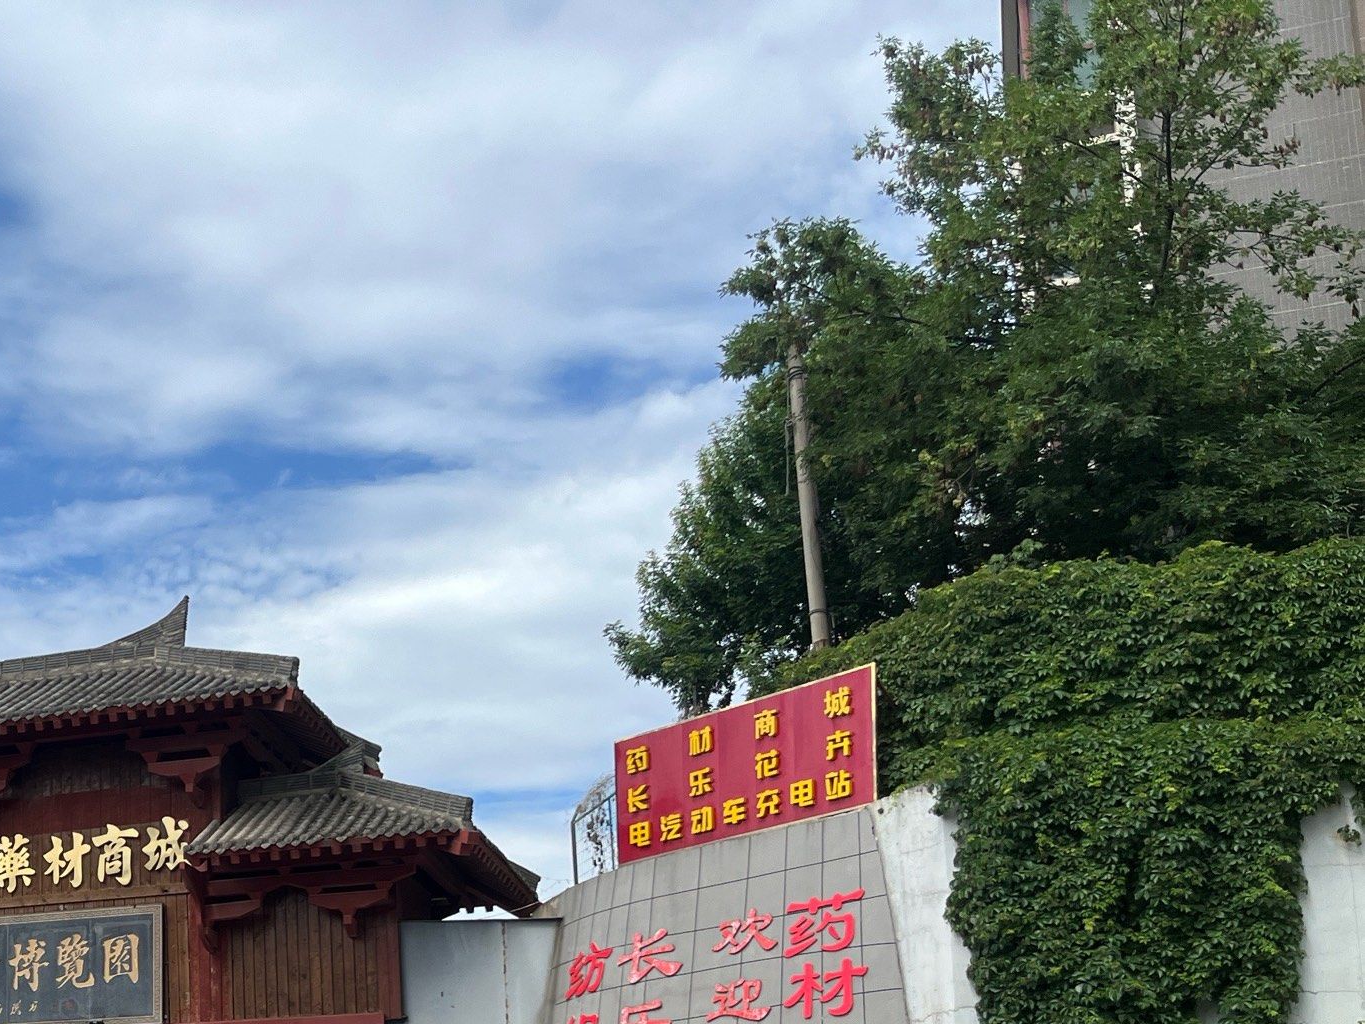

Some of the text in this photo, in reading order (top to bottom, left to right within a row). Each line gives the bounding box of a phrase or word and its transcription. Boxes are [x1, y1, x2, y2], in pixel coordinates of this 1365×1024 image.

[625, 686, 853, 775] 药材商城
[627, 729, 853, 814] 长乐花卉
[629, 769, 853, 848] 电汽动车充电站
